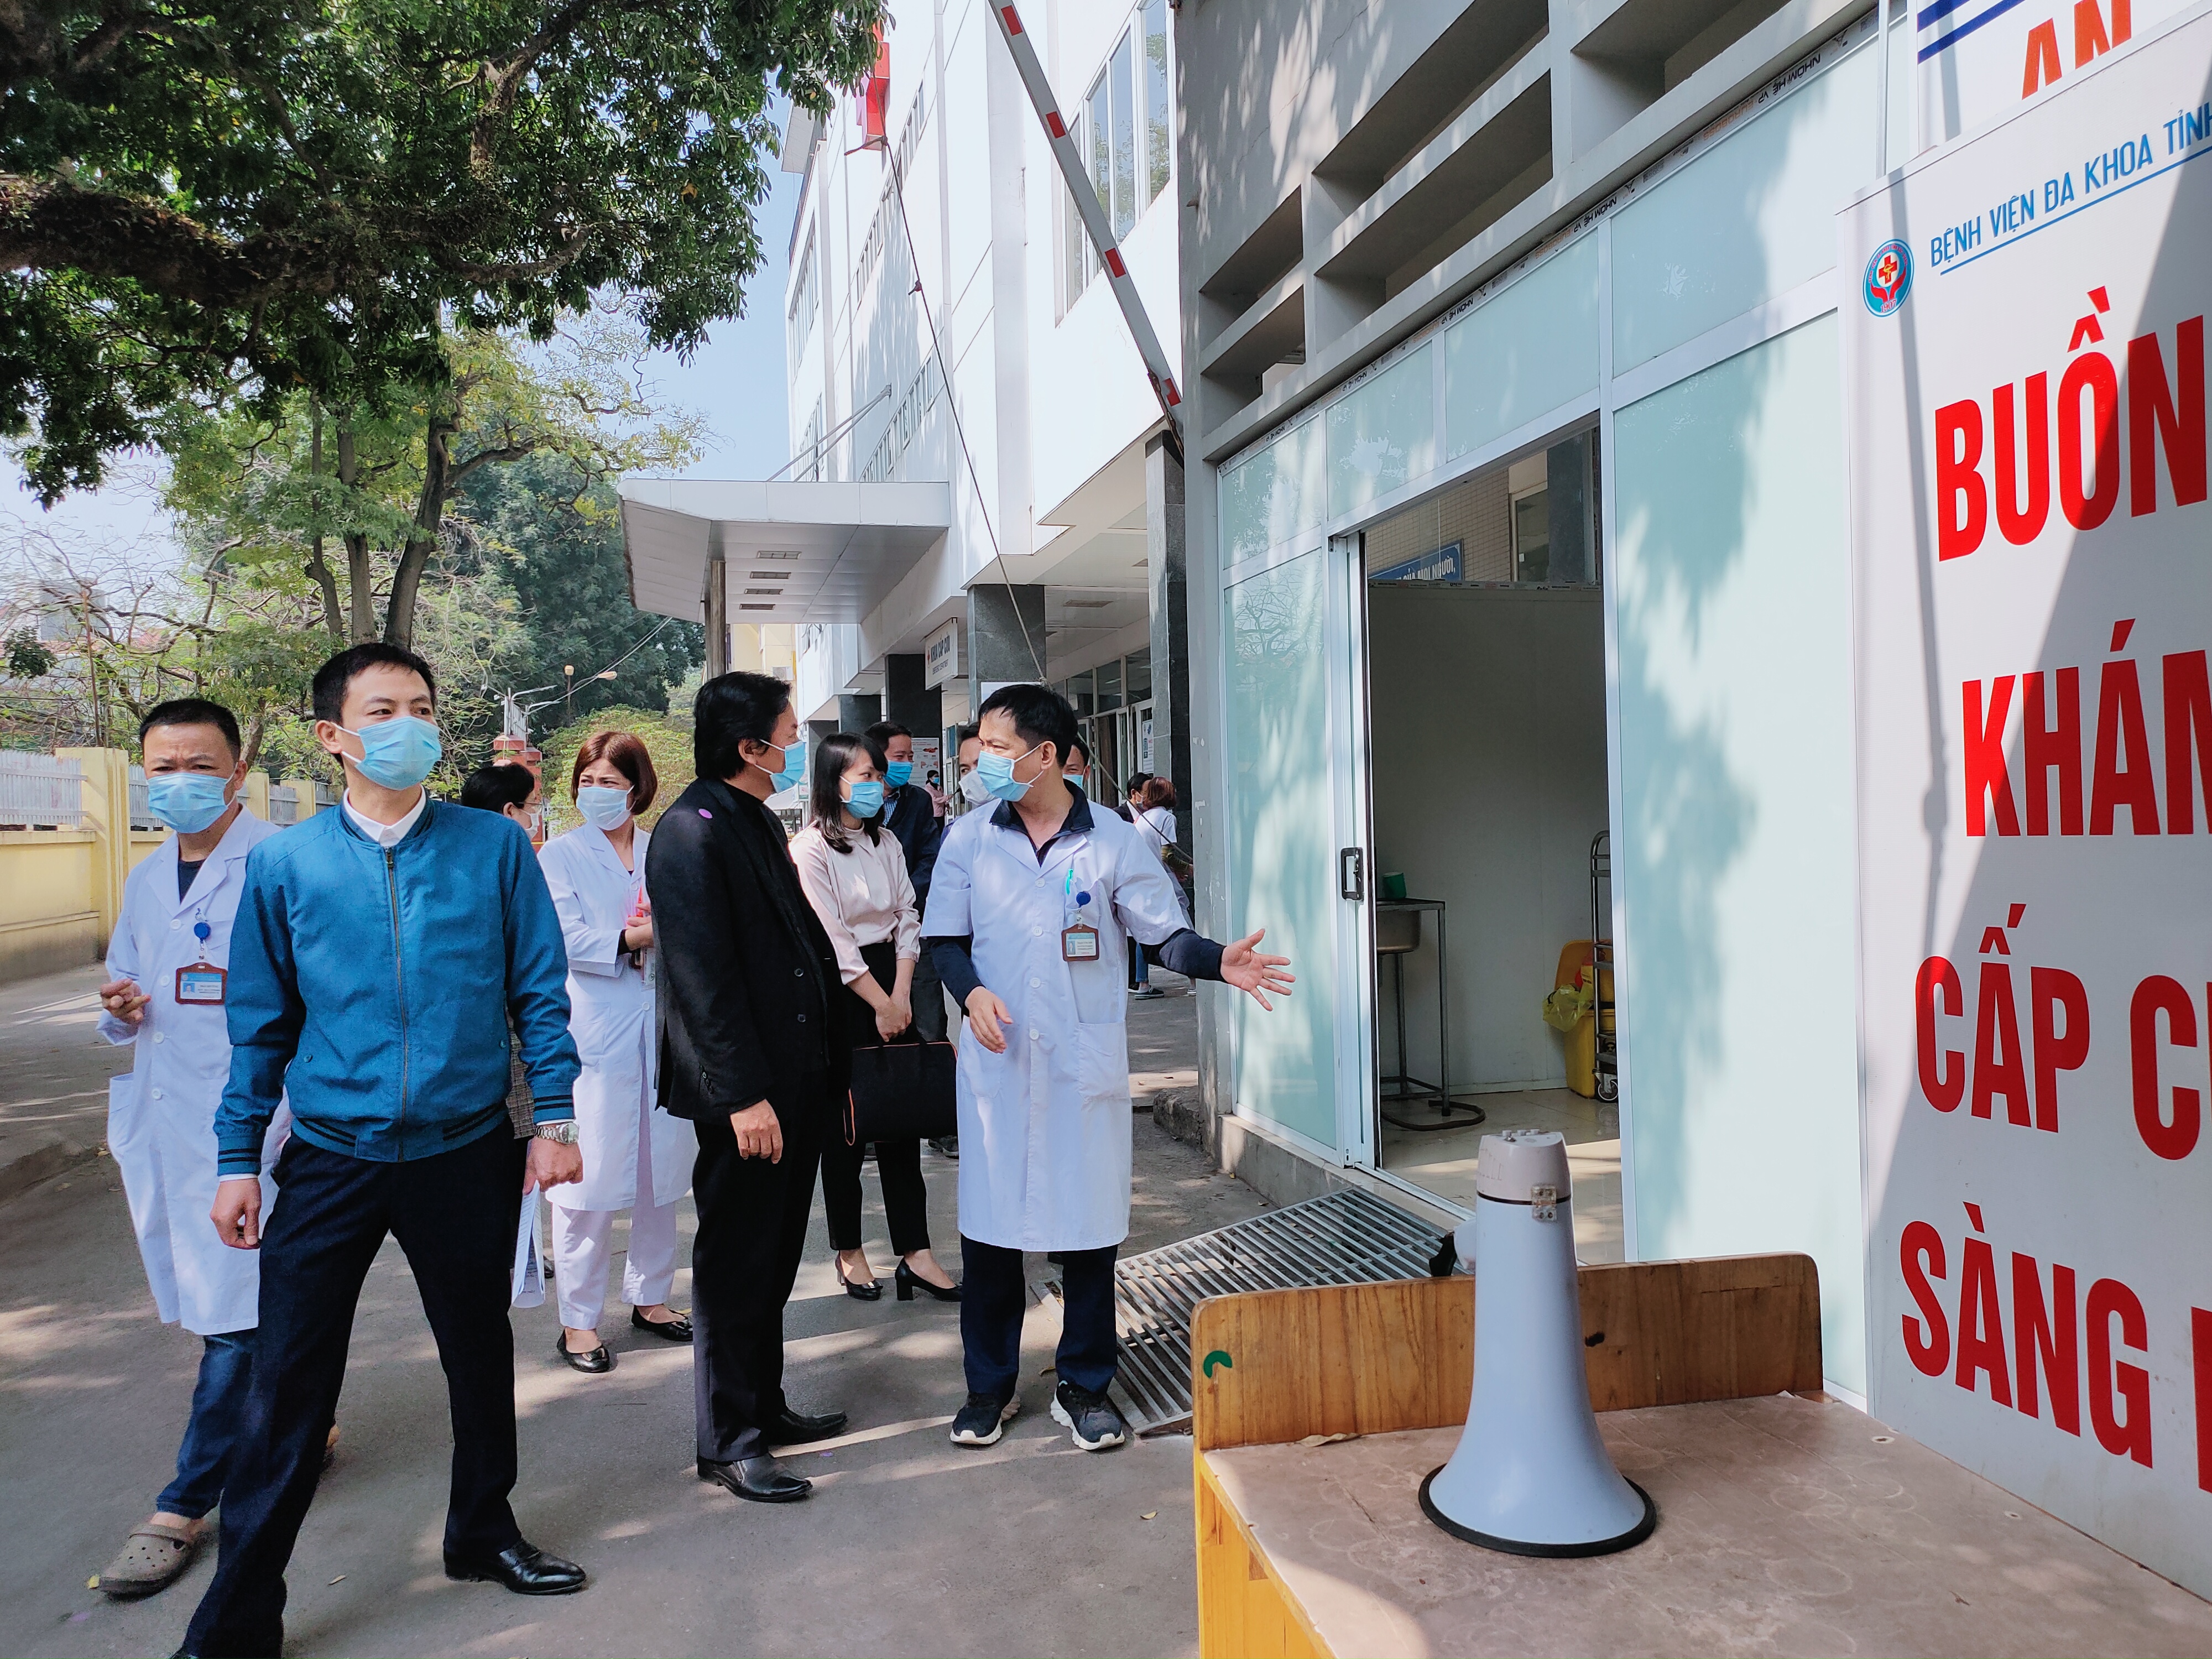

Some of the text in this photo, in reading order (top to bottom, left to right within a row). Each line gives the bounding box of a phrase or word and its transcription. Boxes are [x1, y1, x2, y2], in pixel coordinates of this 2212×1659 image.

[1881, 299, 1897, 313] 1907
[1931, 215, 1982, 268] BỆNH
[1989, 189, 2034, 238] VIỆN
[2044, 171, 2074, 213] ĐA
[2085, 134, 2153, 194] KHOA
[1936, 285, 2208, 562] BUỒN
[1916, 903, 2090, 1133] CẤP
[1900, 1201, 2153, 1469] SÀNG
